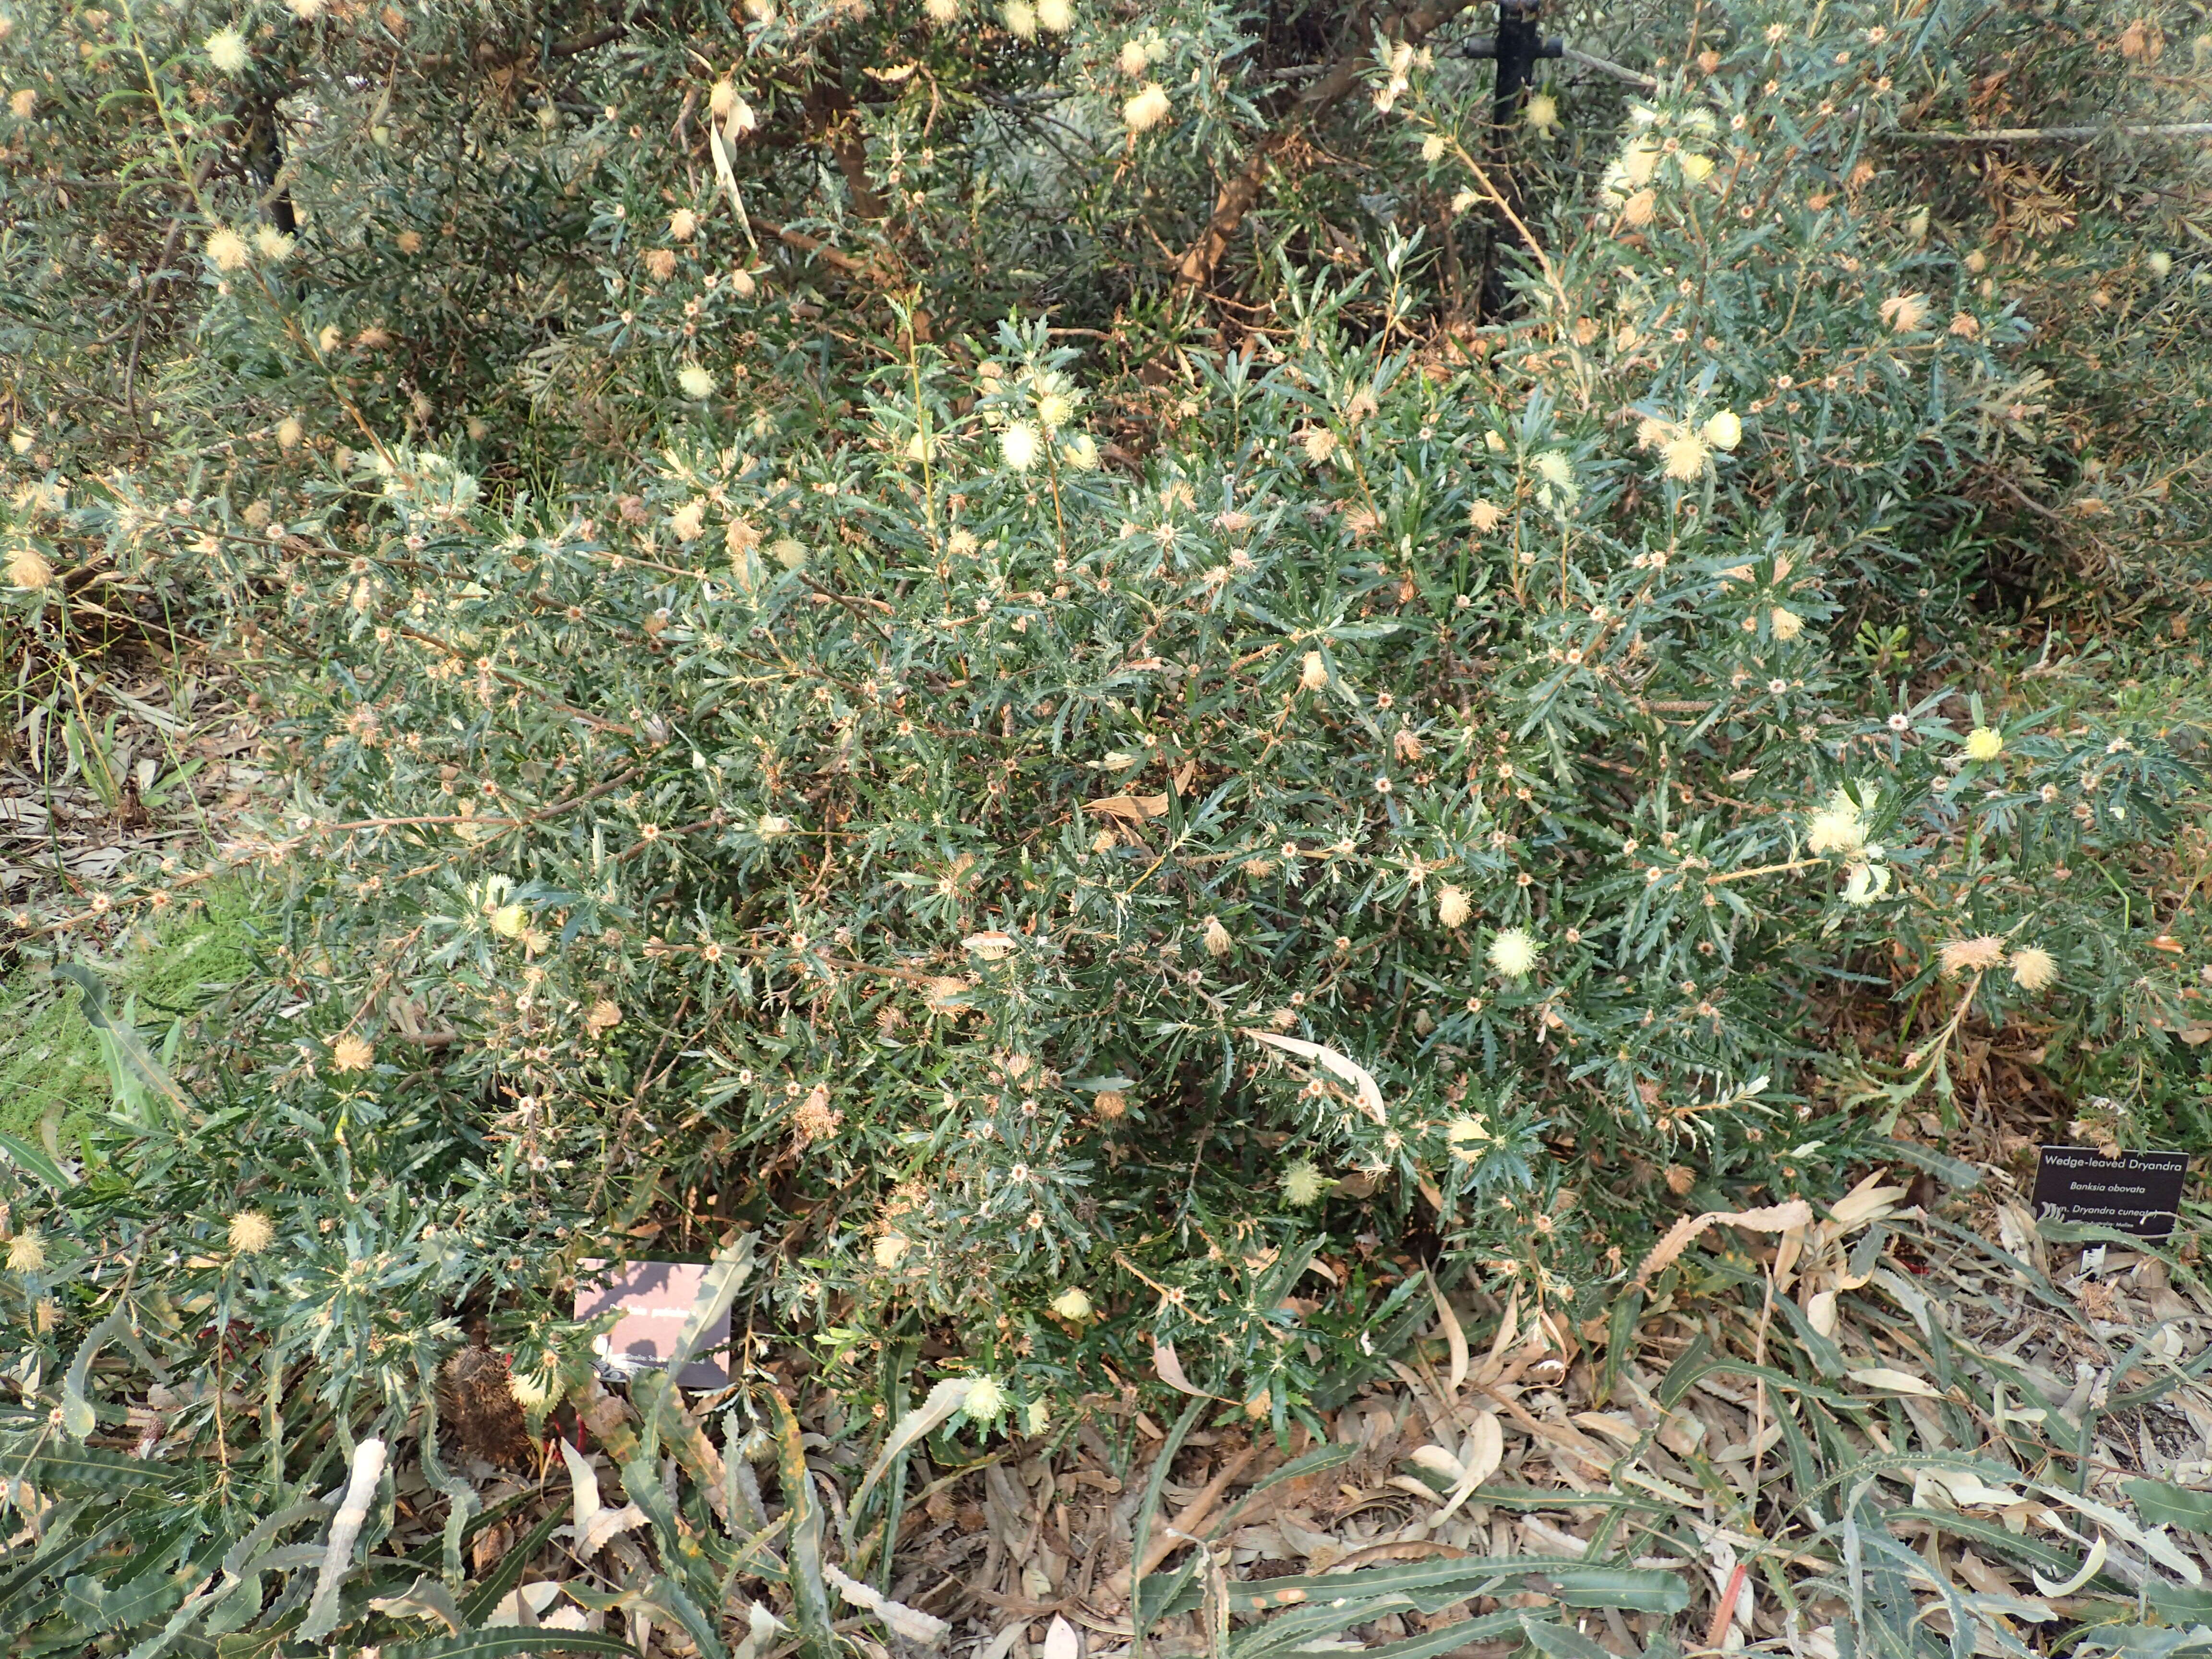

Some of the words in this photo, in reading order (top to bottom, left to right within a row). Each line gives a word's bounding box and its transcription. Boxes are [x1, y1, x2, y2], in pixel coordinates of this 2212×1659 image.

[2045, 1154, 2125, 1169] Wedge-leaved
[2129, 1159, 2182, 1172] Dryandra
[2070, 1181, 2105, 1192] Banksia
[2108, 1184, 2146, 1194] obovata
[2072, 1204, 2116, 1215] Dryandra
[2117, 1208, 2158, 1219] cuneat)
